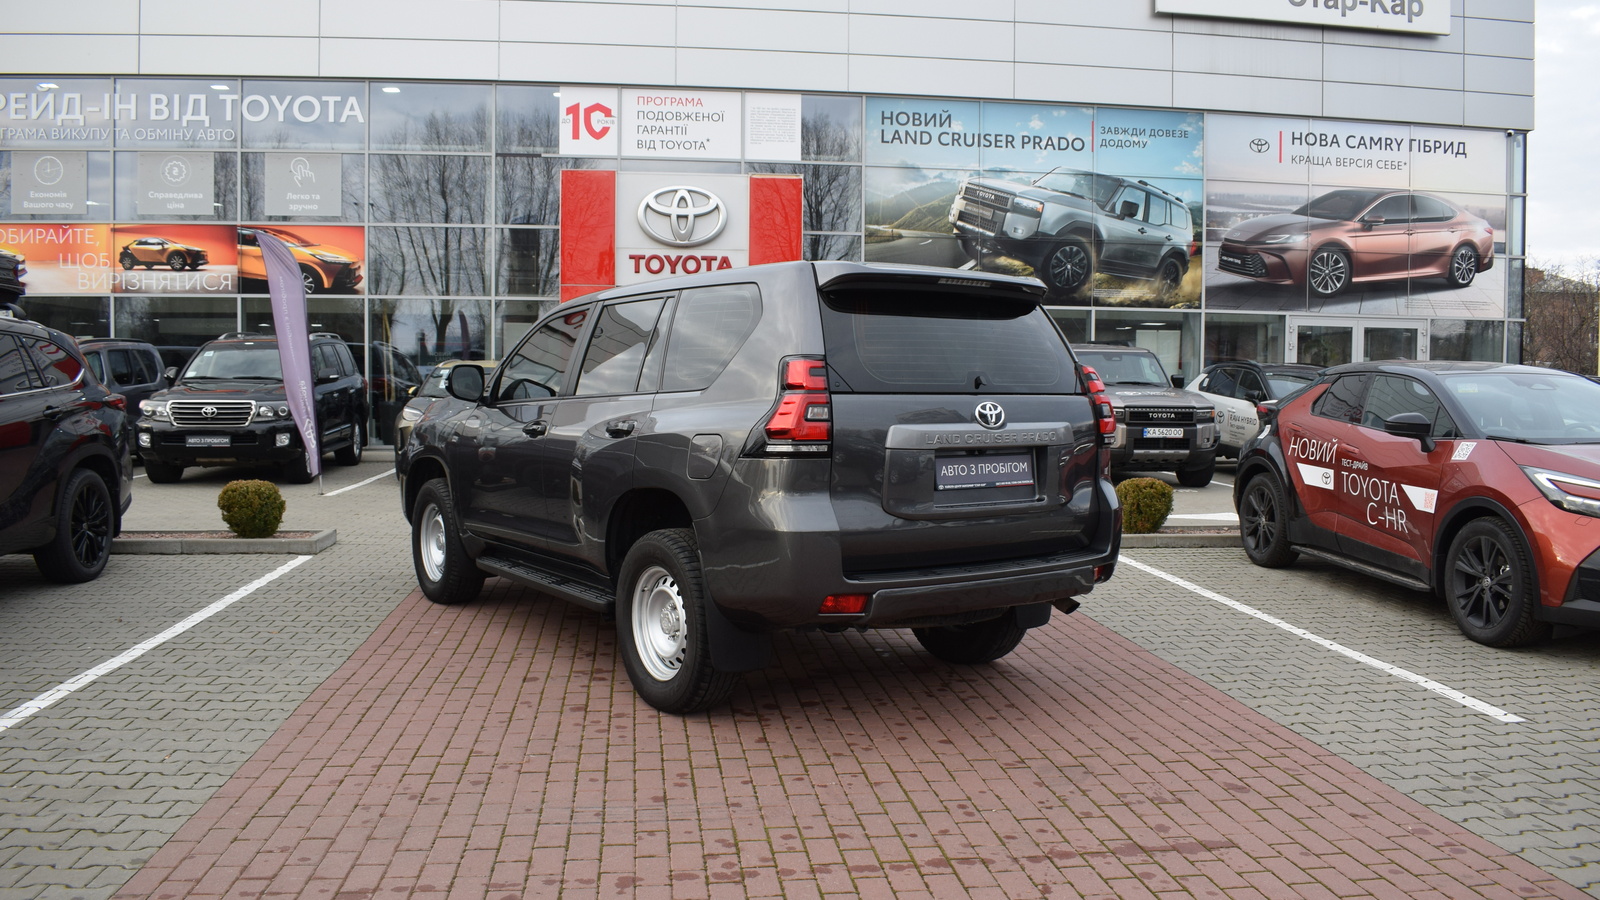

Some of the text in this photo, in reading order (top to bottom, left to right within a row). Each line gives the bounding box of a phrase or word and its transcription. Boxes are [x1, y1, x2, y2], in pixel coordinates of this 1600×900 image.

[637, 95, 703, 107] ПРОГРАМА
[150, 93, 210, 127] ВІД
[219, 93, 365, 123] TOYOTA
[637, 110, 725, 122] ПОДОВЖЕНОЇ
[880, 109, 952, 128] НОВИЙ
[52, 128, 110, 141] ВИКУПУ
[115, 129, 131, 141] ТА
[135, 129, 193, 141] ОБМІНУ
[197, 129, 235, 141] АВТО
[637, 124, 688, 136] ГАРАНТІЇ
[1100, 126, 1189, 139] ЗАВЖДИ ДОВЕЗЕ
[637, 140, 656, 151] ВІД
[880, 129, 1085, 152] LAND CRUISER PRADO
[1100, 138, 1148, 149] ДОДОМУ
[1291, 132, 1467, 158] НОВА CAMRY ГІБРИД
[1291, 155, 1332, 167] КРАЩА
[1336, 157, 1373, 168] ВЕРСІЯ
[148, 191, 203, 199] Справедлива
[286, 192, 310, 200] Легко
[976, 191, 995, 200] TOYOTA
[289, 203, 318, 211] зручно
[59, 252, 110, 271] ЩОБ
[629, 254, 732, 275] TOYOTA
[78, 272, 232, 290] ВИРІЗНЯТИСЯ
[925, 431, 1057, 445] LAND CRUISER PRADO
[1288, 436, 1338, 464] НОВИЙ
[940, 462, 1027, 476] АВТО З ПРОБІГОМ
[1341, 471, 1400, 506] TOYOTA
[1366, 502, 1409, 534] C-HR
